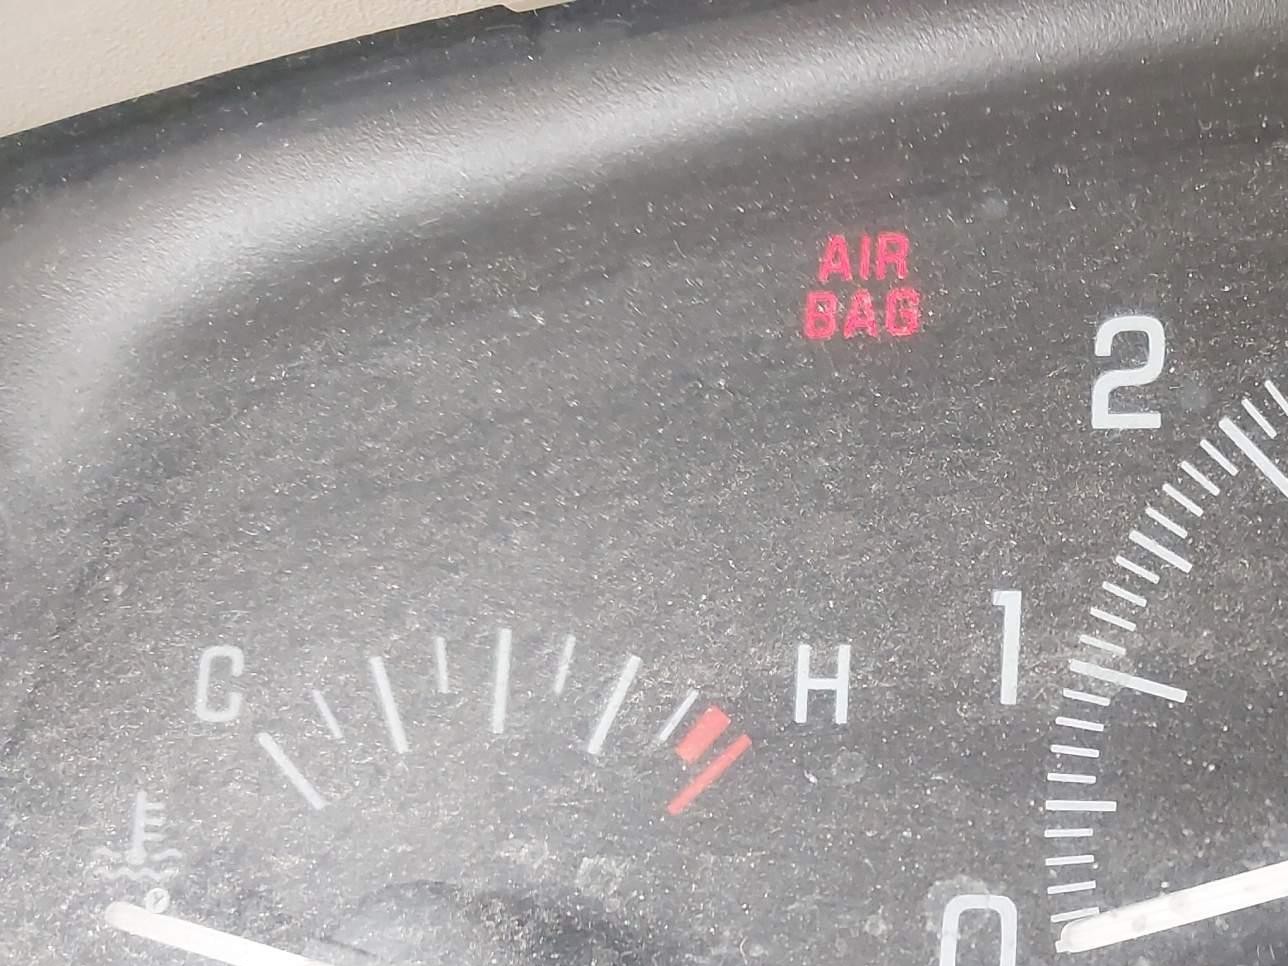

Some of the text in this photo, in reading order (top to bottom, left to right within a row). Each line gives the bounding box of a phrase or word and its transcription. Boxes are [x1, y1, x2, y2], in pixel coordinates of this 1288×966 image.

[818, 231, 911, 283] AIR
[804, 288, 921, 340] BAG
[1091, 315, 1166, 430] 2
[199, 645, 244, 722] C
[794, 644, 850, 725] H
[992, 590, 1022, 705] 1
